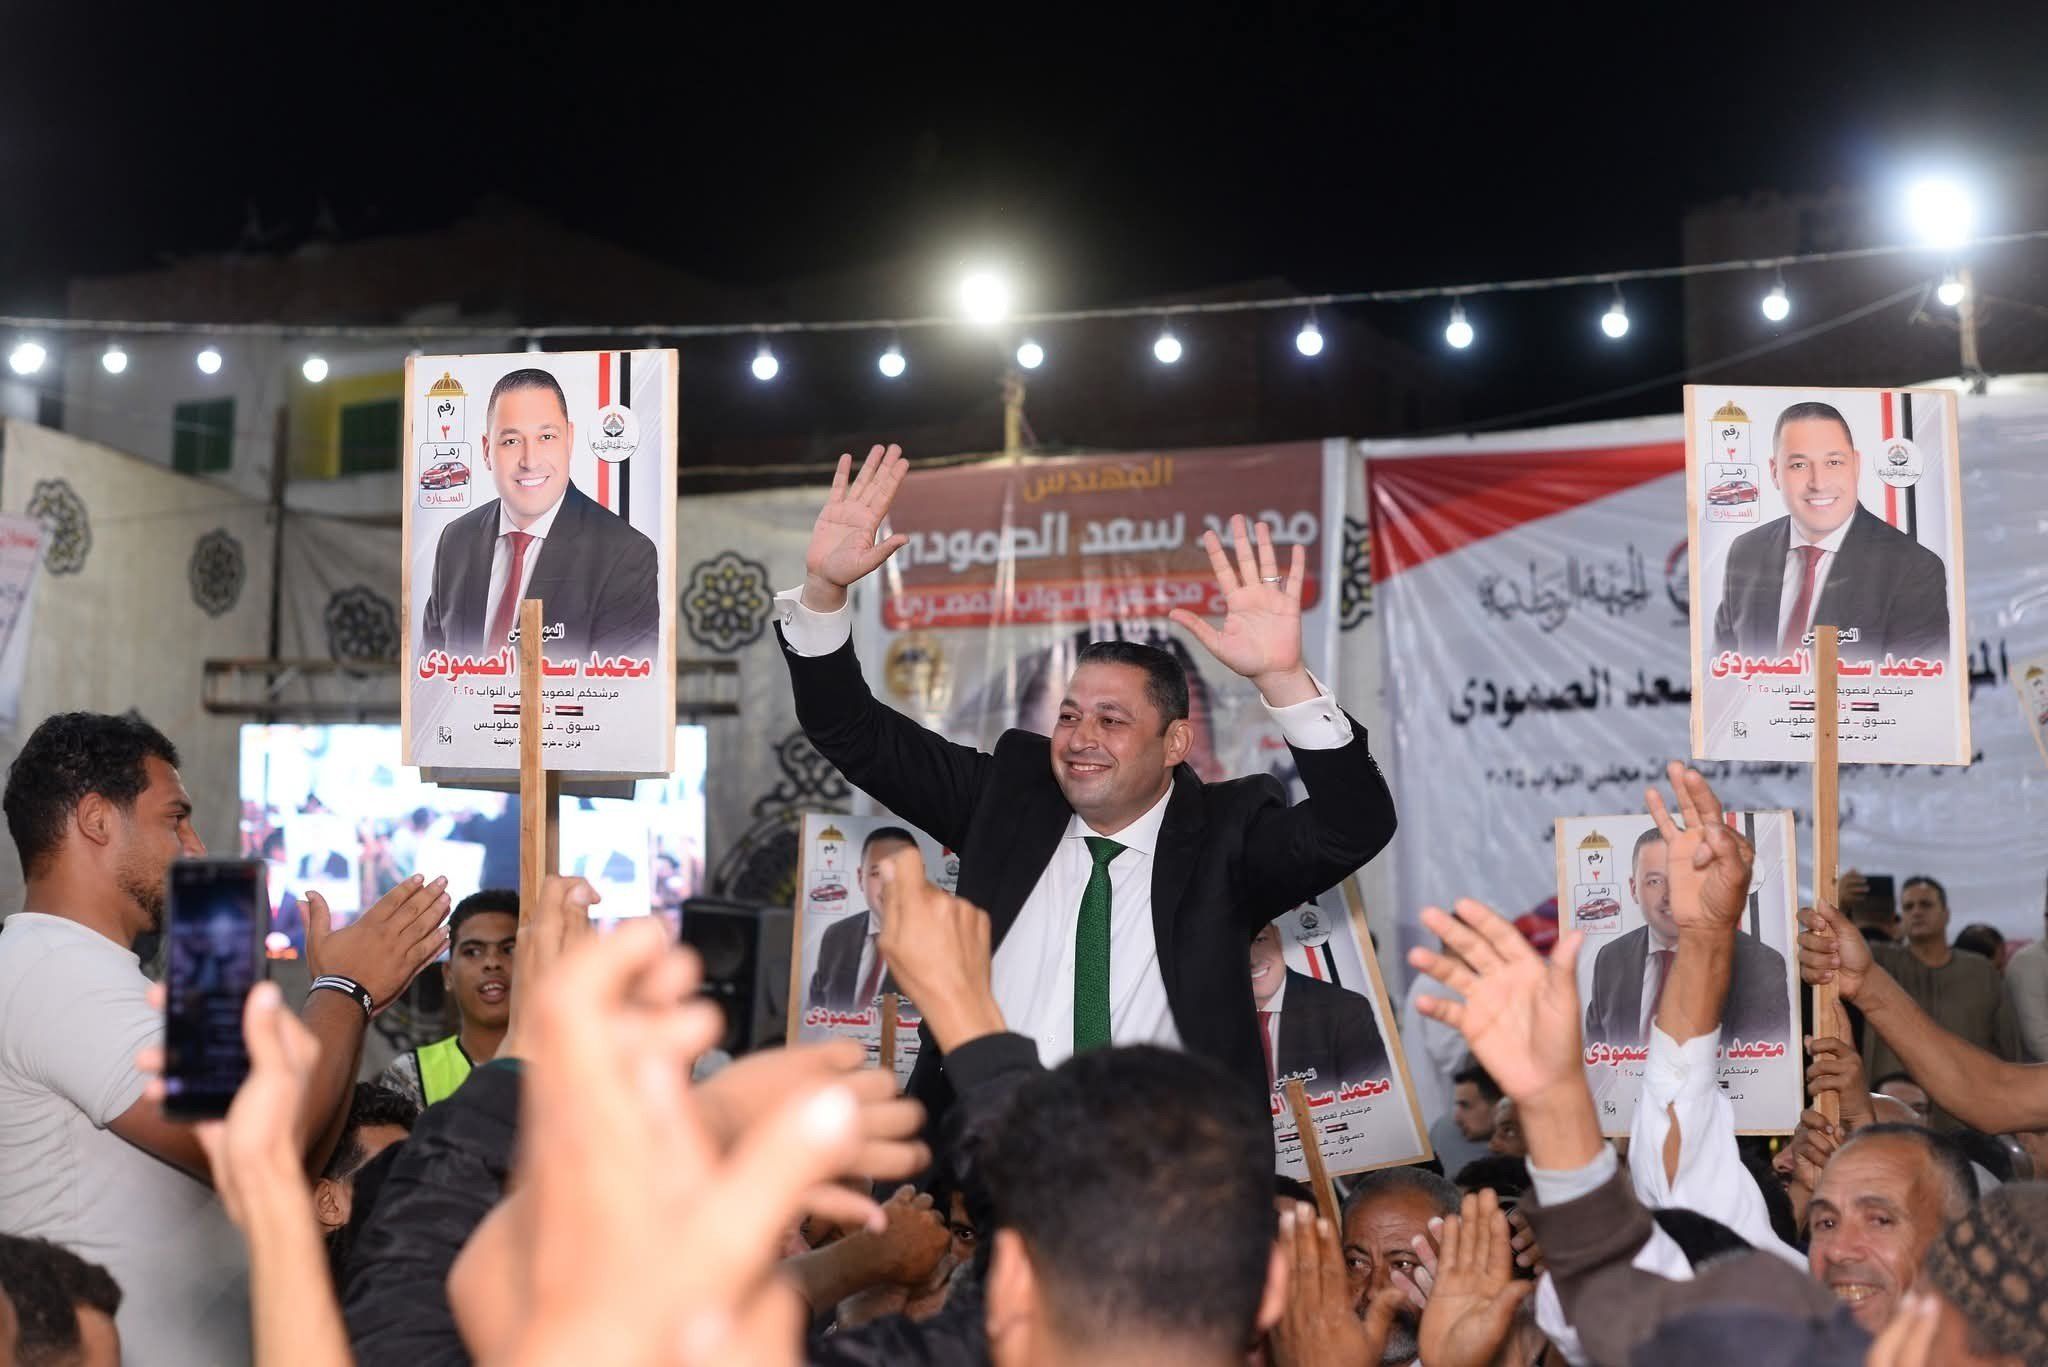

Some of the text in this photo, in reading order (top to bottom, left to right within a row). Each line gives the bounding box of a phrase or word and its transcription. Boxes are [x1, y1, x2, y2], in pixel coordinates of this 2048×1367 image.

[437, 399, 455, 418] رقم
[441, 424, 451, 440] ٣
[1722, 424, 1740, 441] رقم
[433, 445, 460, 460] رمز
[1727, 448, 1736, 462] ٣
[1023, 455, 1174, 503] المهندس
[1720, 465, 1747, 479] رمز
[1078, 511, 1186, 554] سعد
[508, 623, 564, 642] المهس
[419, 647, 515, 682] الصمودى
[585, 652, 651, 678] محمد
[1711, 648, 1810, 681] الصمودى
[1880, 653, 1944, 678] محمد
[476, 685, 506, 698] النواب
[473, 717, 519, 732] مطوبس
[565, 721, 601, 735] دسوق
[1862, 715, 1897, 729] دسوق
[1588, 851, 1603, 865] رقم
[1728, 1039, 1785, 1059] محمد
[1340, 1078, 1391, 1102] محمد
